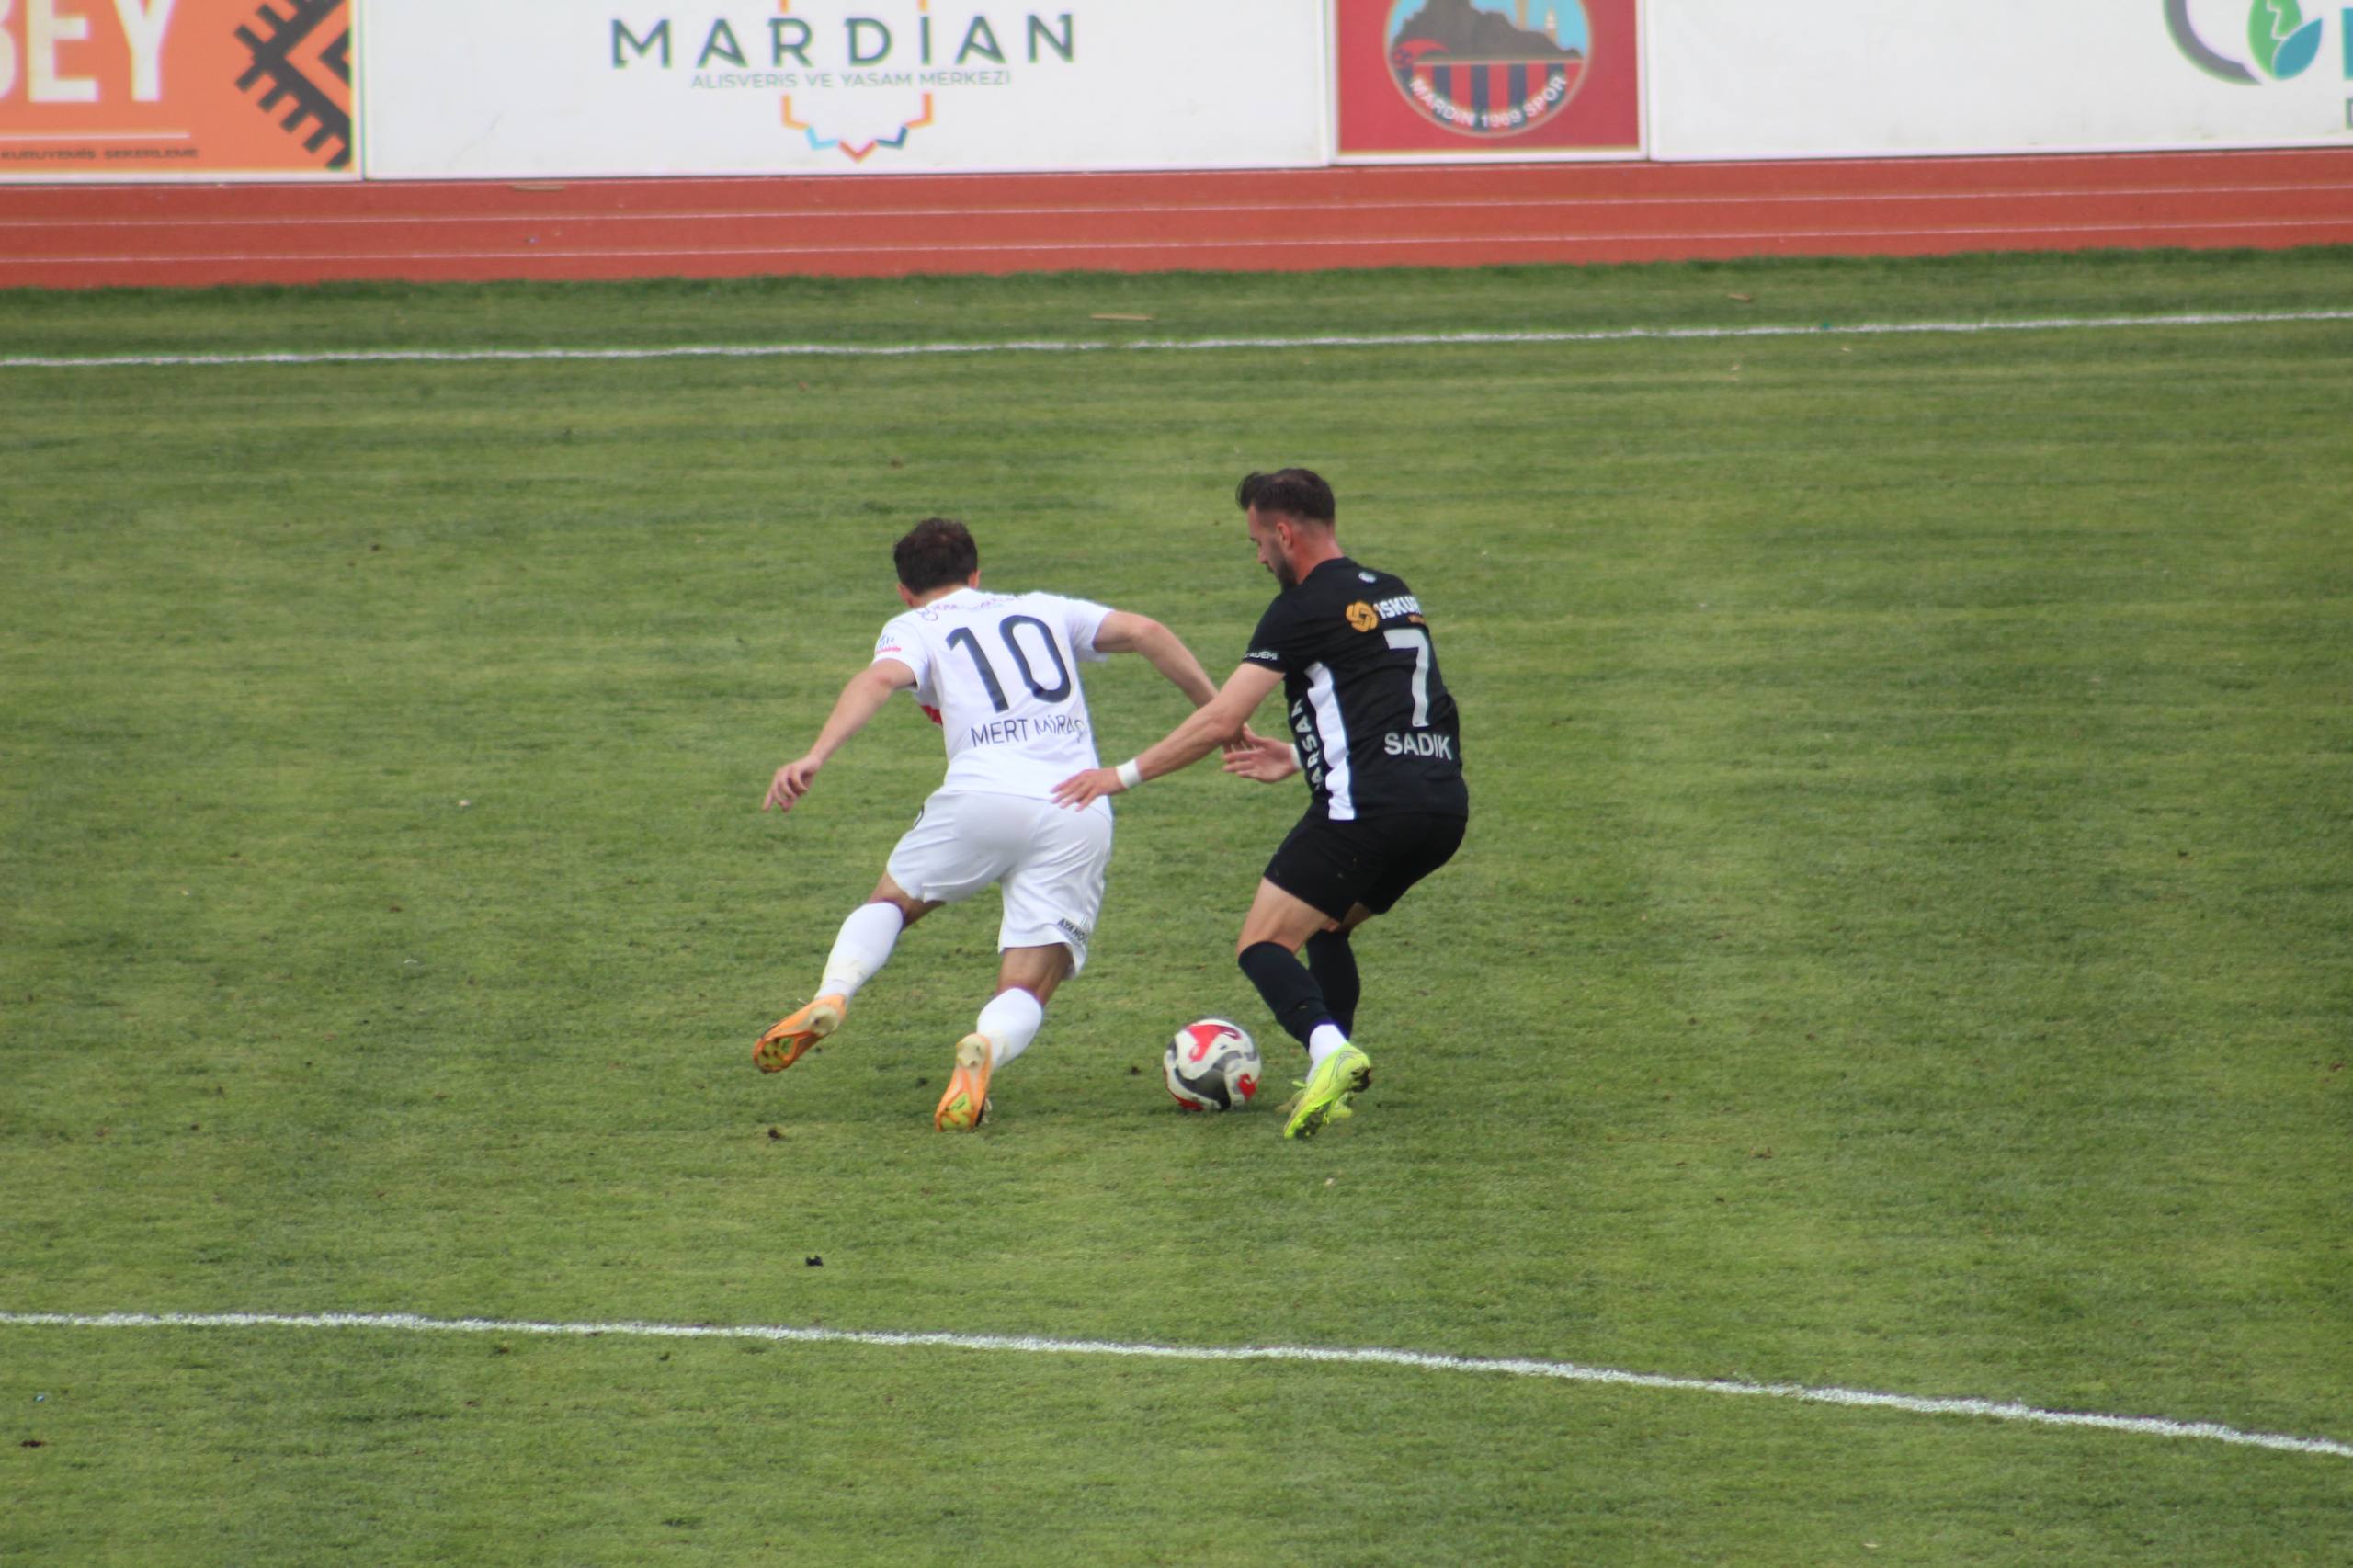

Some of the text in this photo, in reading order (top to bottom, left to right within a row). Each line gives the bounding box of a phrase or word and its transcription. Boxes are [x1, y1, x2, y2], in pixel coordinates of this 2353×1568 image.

[0, 0, 176, 102] EY
[805, 72, 834, 88] VE
[1481, 109, 1522, 128] 1969
[1522, 74, 1567, 118] SPOR
[946, 614, 1072, 714] 10
[1383, 628, 1430, 728] 7
[971, 718, 1029, 747] MERT
[1384, 732, 1452, 761] SADIK
